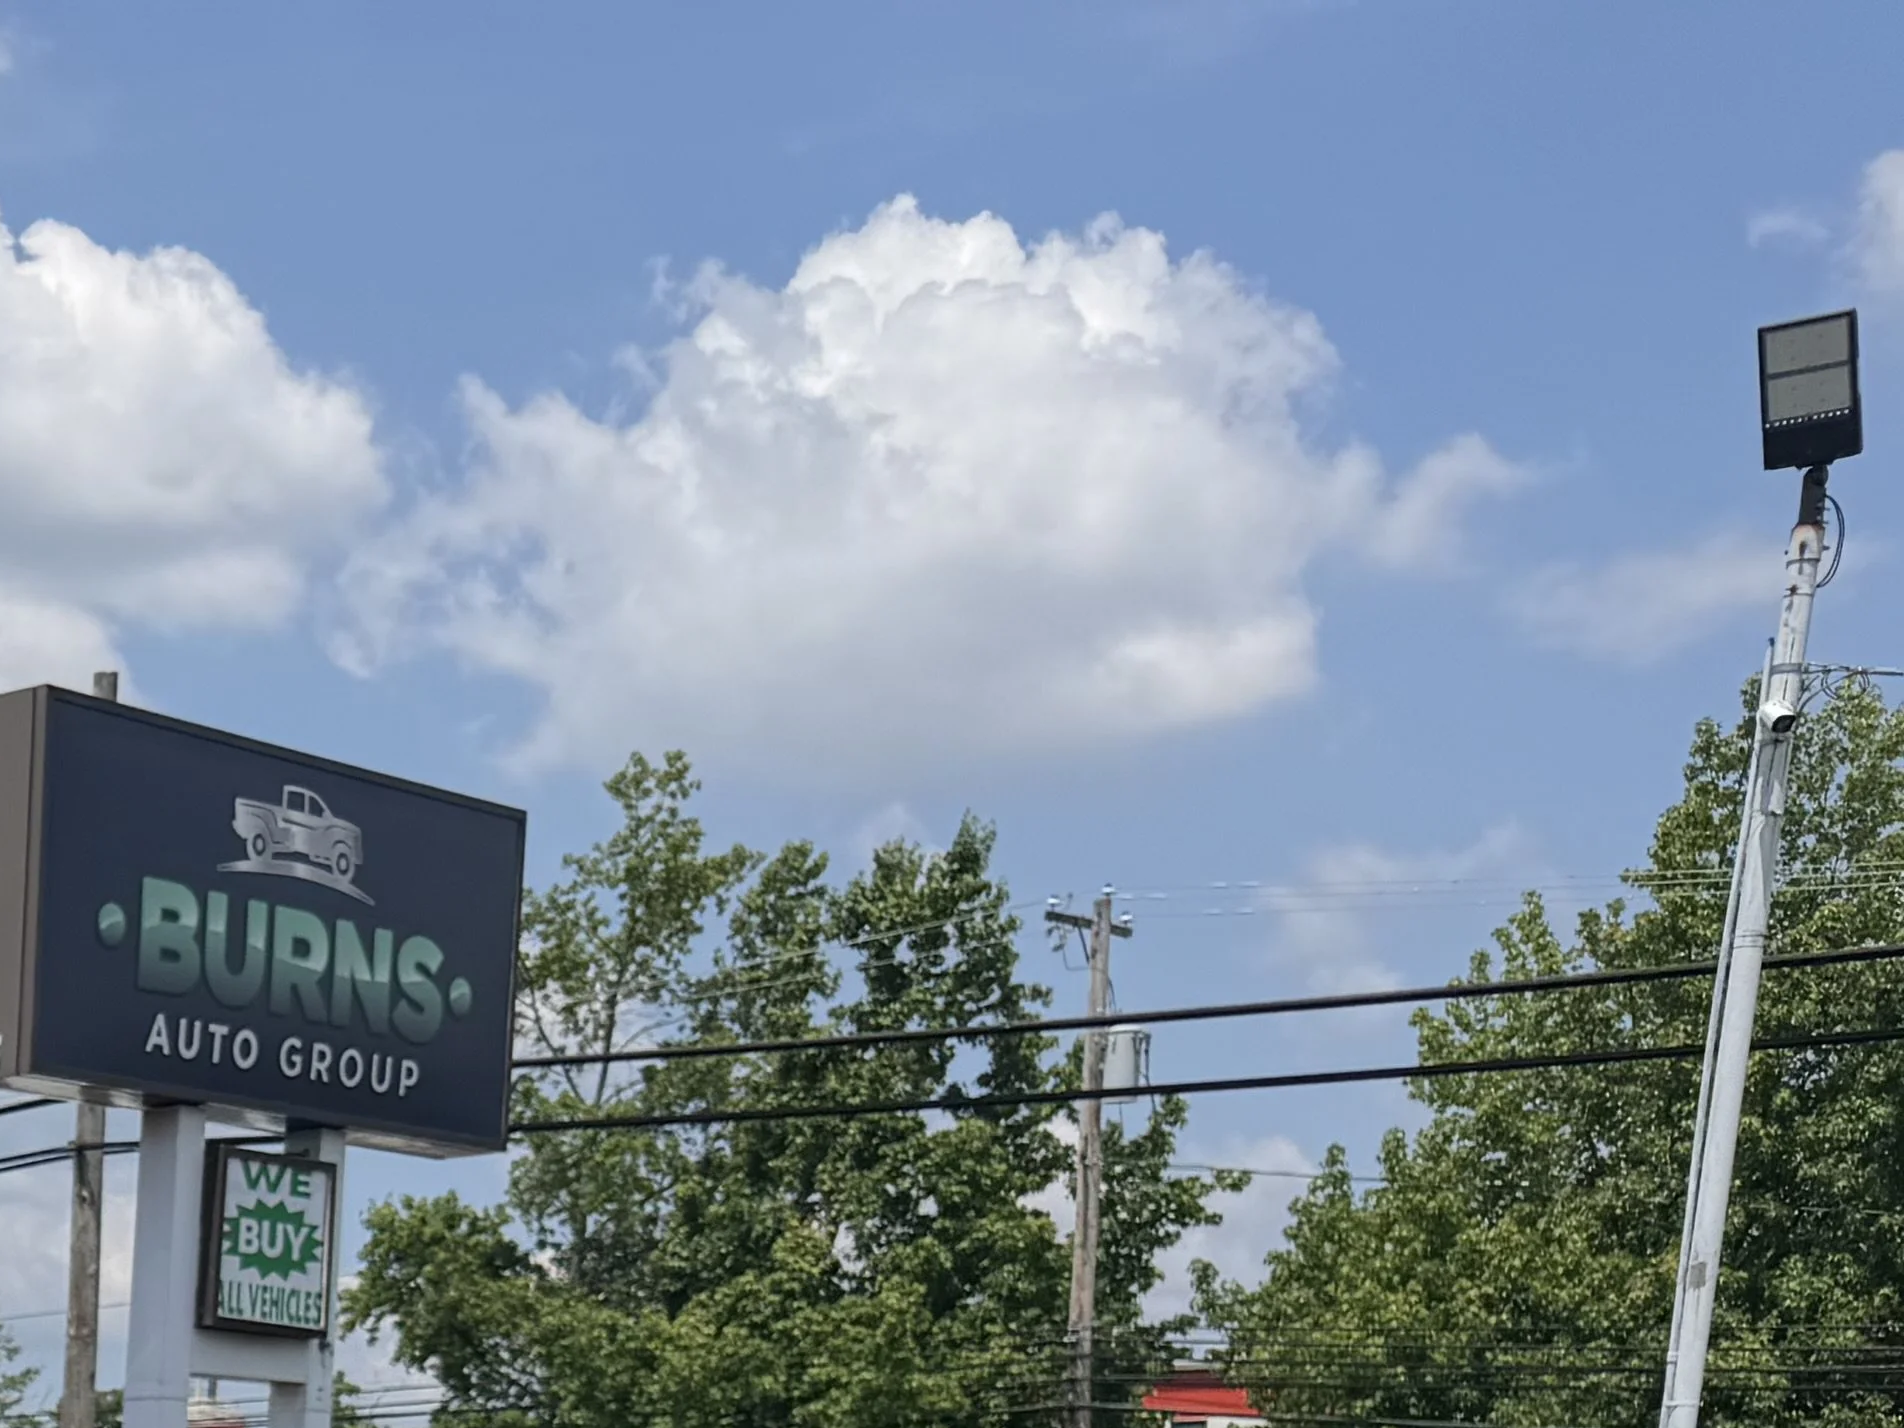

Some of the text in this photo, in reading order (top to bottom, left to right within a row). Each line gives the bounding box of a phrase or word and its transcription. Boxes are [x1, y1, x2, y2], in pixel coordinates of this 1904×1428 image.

[136, 876, 448, 1045] BURNS
[145, 1011, 421, 1098] AUTO GROUP
[242, 1160, 312, 1200] WE
[237, 1216, 312, 1262] BUY
[248, 1283, 324, 1327] VEHICLES
